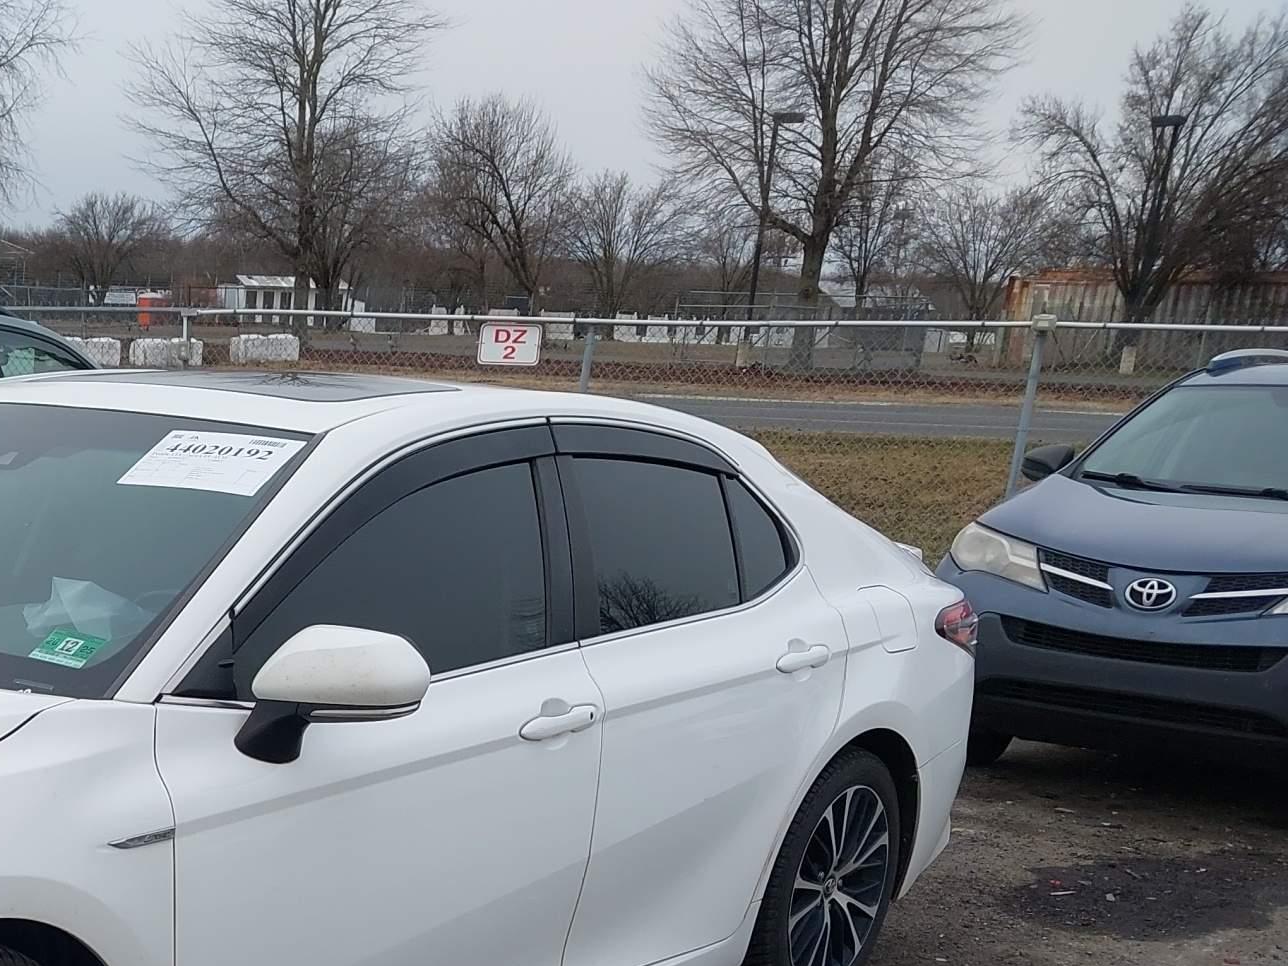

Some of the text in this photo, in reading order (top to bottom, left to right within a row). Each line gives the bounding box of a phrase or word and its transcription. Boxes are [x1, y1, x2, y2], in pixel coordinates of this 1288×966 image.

[494, 328, 528, 344] DZ
[502, 345, 516, 360] 2
[166, 442, 273, 461] 44020192
[57, 639, 80, 653] 12
[79, 645, 96, 655] 25
